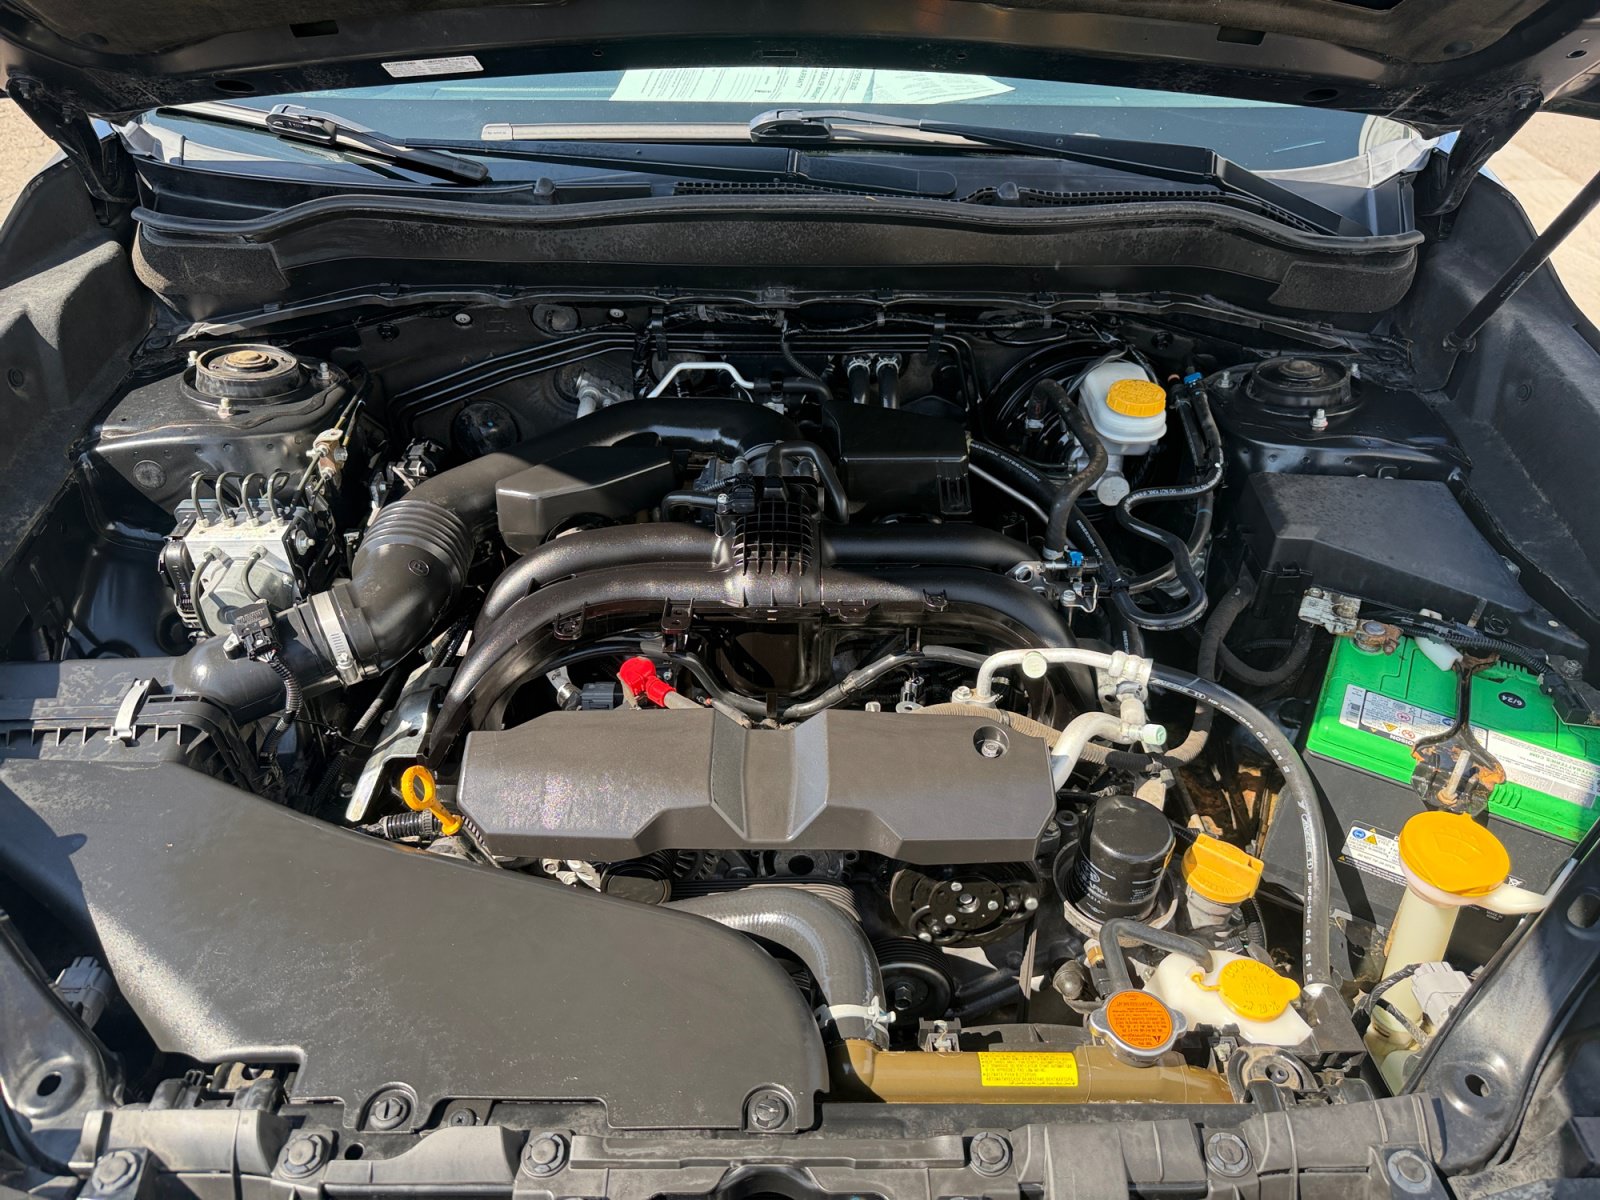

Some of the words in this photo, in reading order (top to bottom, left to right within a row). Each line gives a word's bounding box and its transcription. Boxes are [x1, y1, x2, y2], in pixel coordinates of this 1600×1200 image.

[1500, 693, 1523, 707] 6/24
[1388, 734, 1414, 745] OISON
[1307, 872, 1312, 883] HP
[1305, 929, 1311, 945] GA
[1305, 953, 1311, 967] 21
